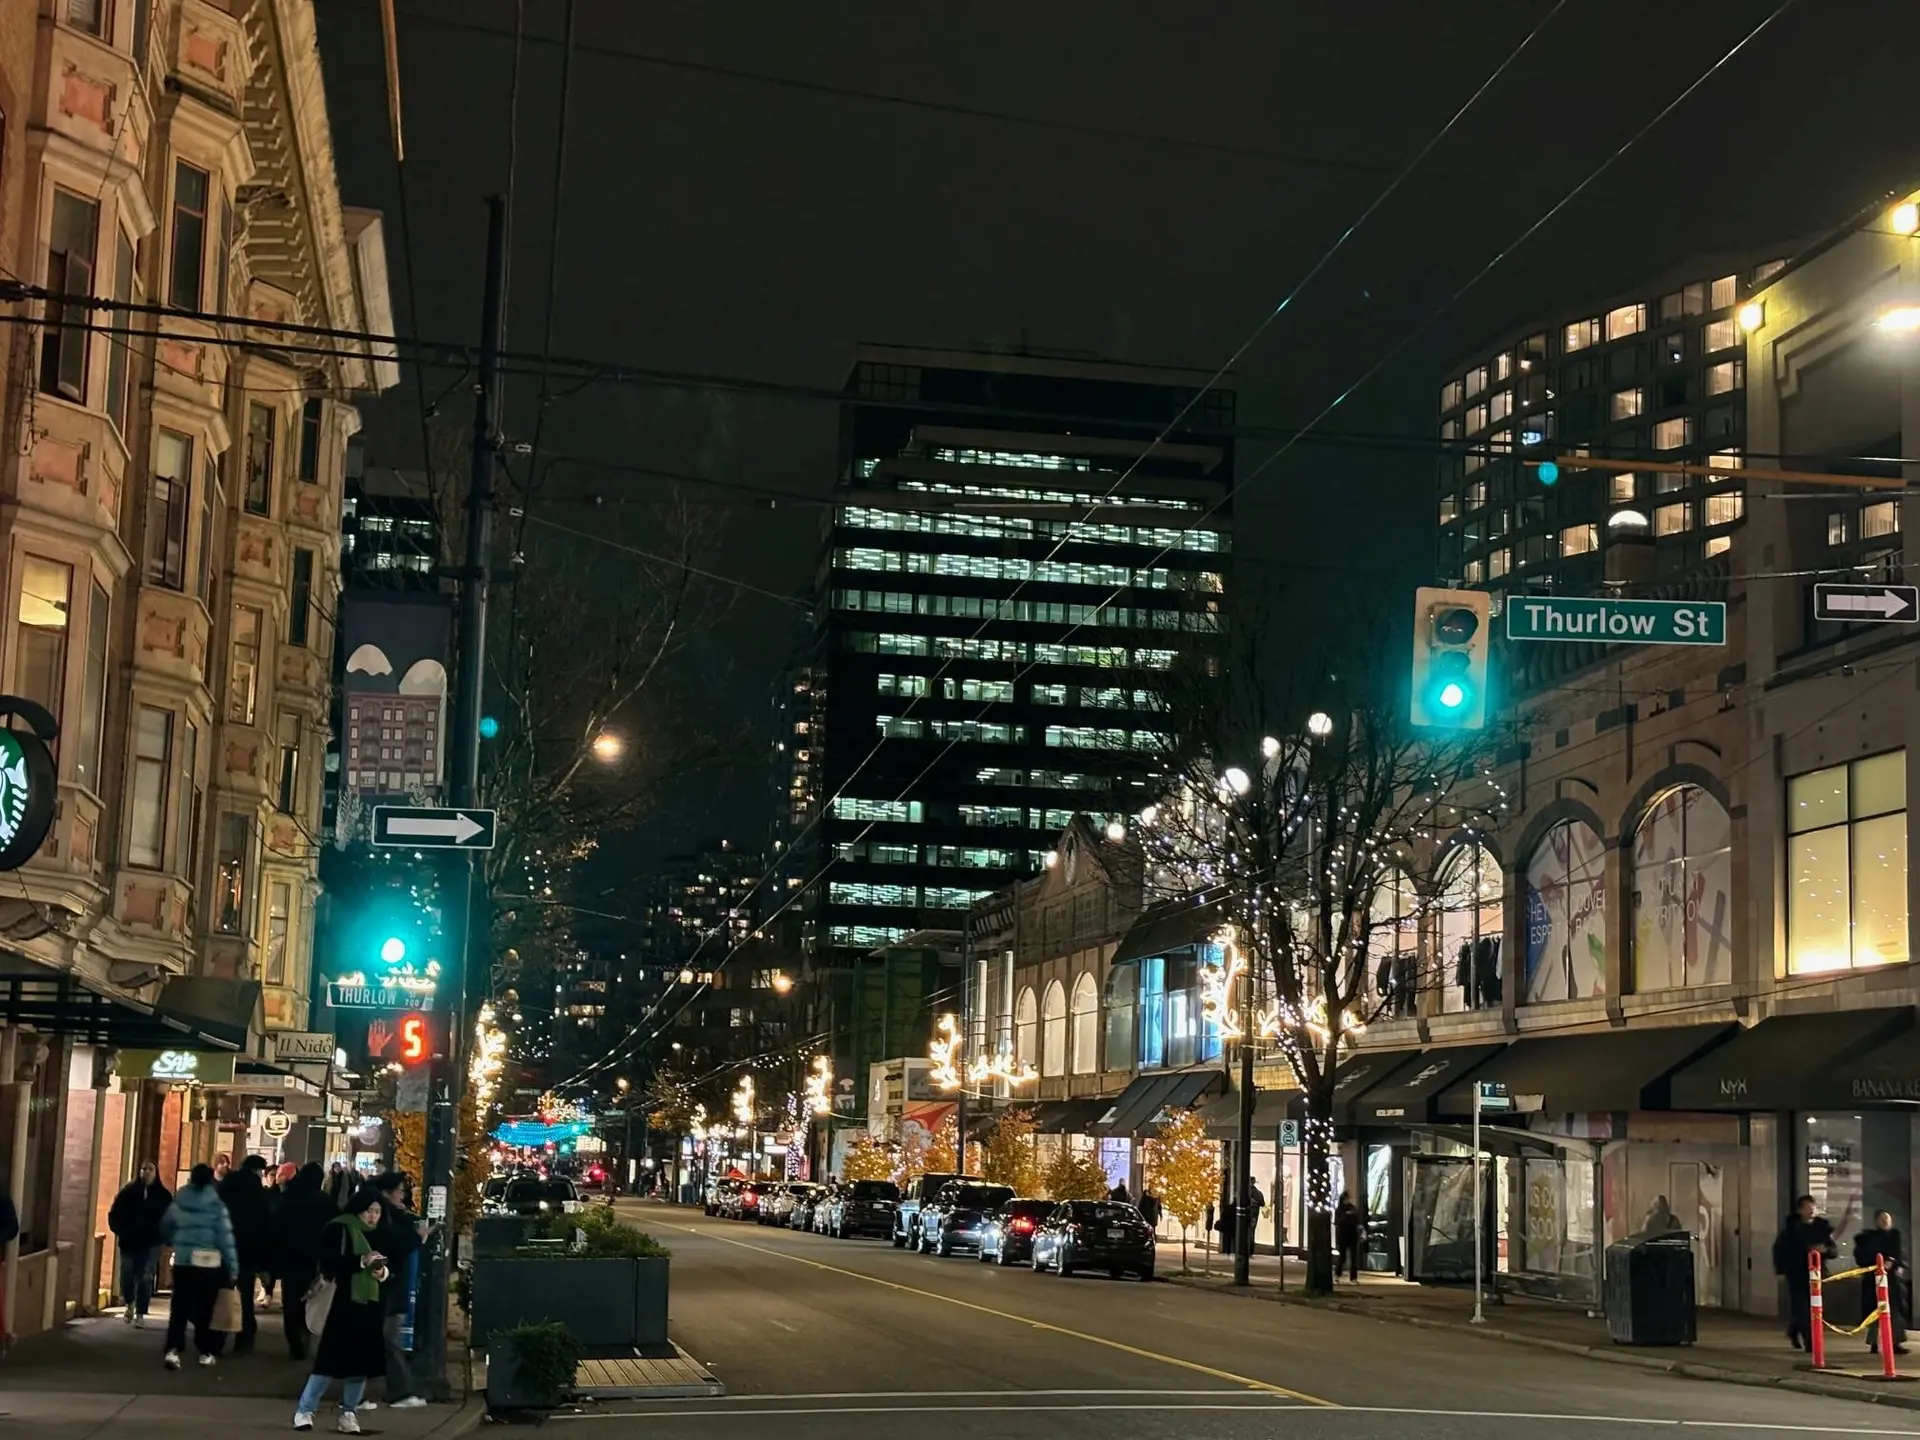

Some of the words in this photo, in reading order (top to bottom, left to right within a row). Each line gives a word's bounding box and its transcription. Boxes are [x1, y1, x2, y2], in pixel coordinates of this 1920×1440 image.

[1524, 605, 1656, 635] Thurlow
[1673, 608, 1709, 637] St
[338, 987, 397, 1005] THURLOW
[404, 999, 419, 1007] 700
[280, 1037, 291, 1052] Il
[404, 1020, 421, 1057] 5
[1482, 1083, 1493, 1096] T
[1720, 1078, 1748, 1094] NYX
[1852, 1078, 1902, 1098] BANANA
